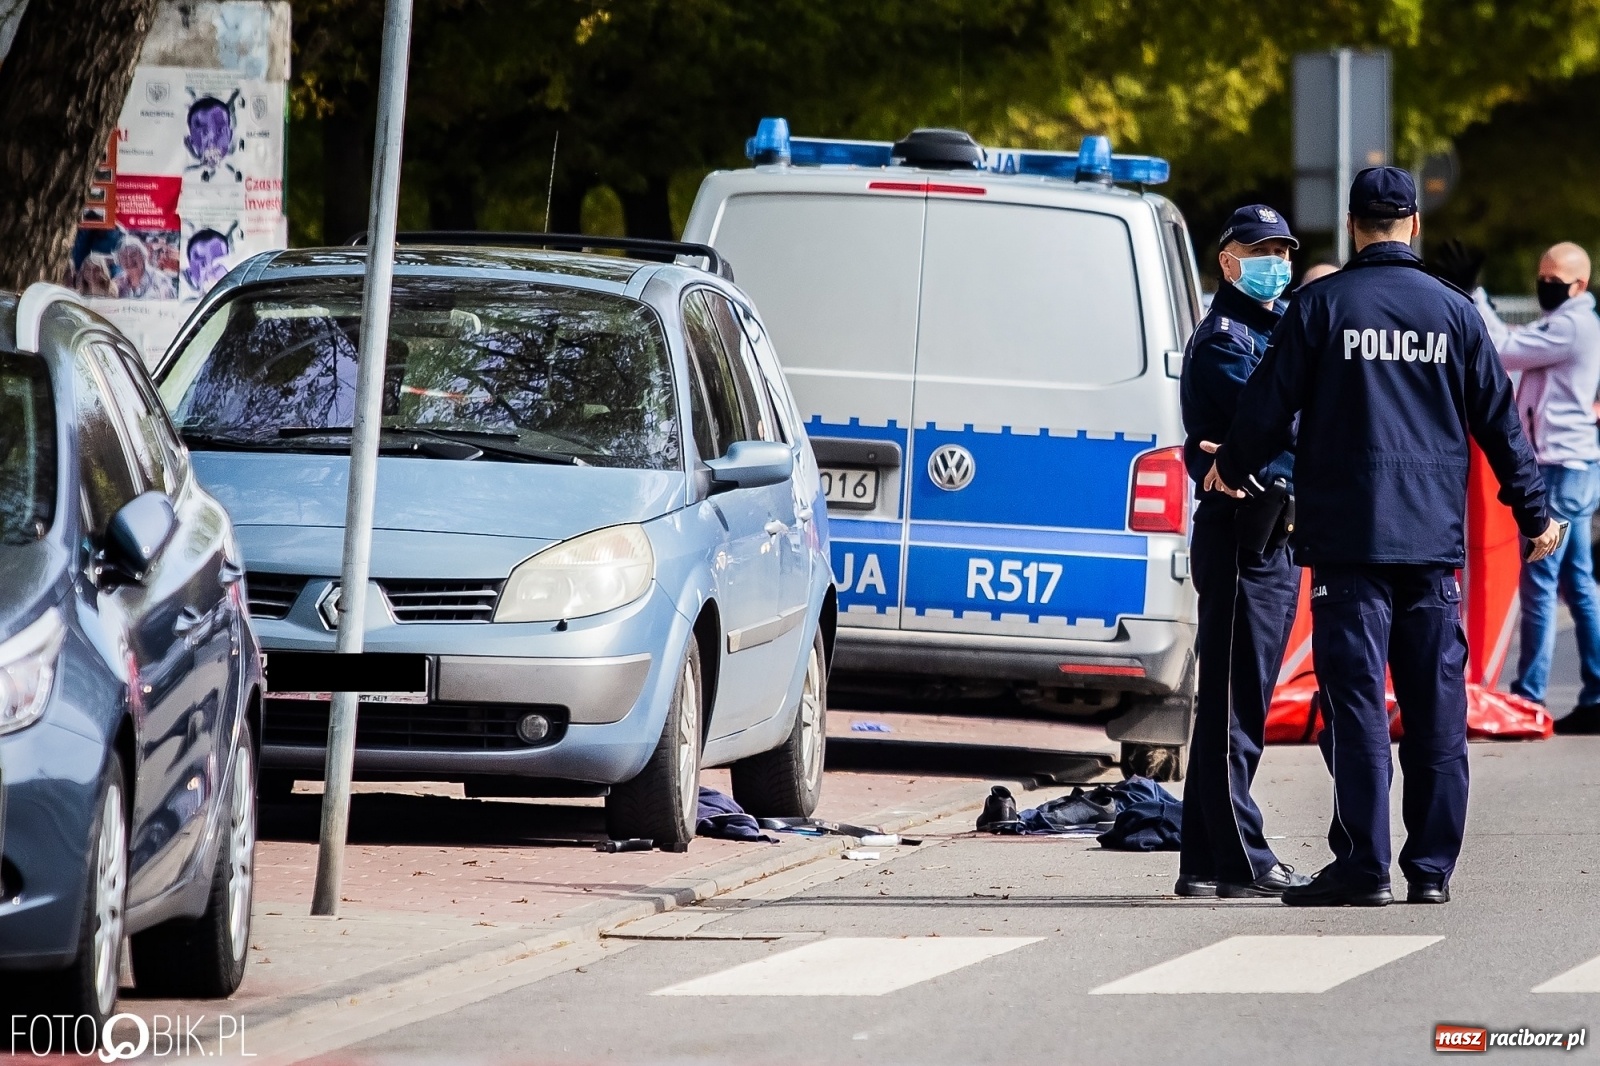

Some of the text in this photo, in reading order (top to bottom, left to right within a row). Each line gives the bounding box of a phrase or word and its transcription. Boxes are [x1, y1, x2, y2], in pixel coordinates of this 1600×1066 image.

[1343, 328, 1447, 363] POLICJA
[820, 472, 868, 498] 016
[966, 558, 1063, 604] R517
